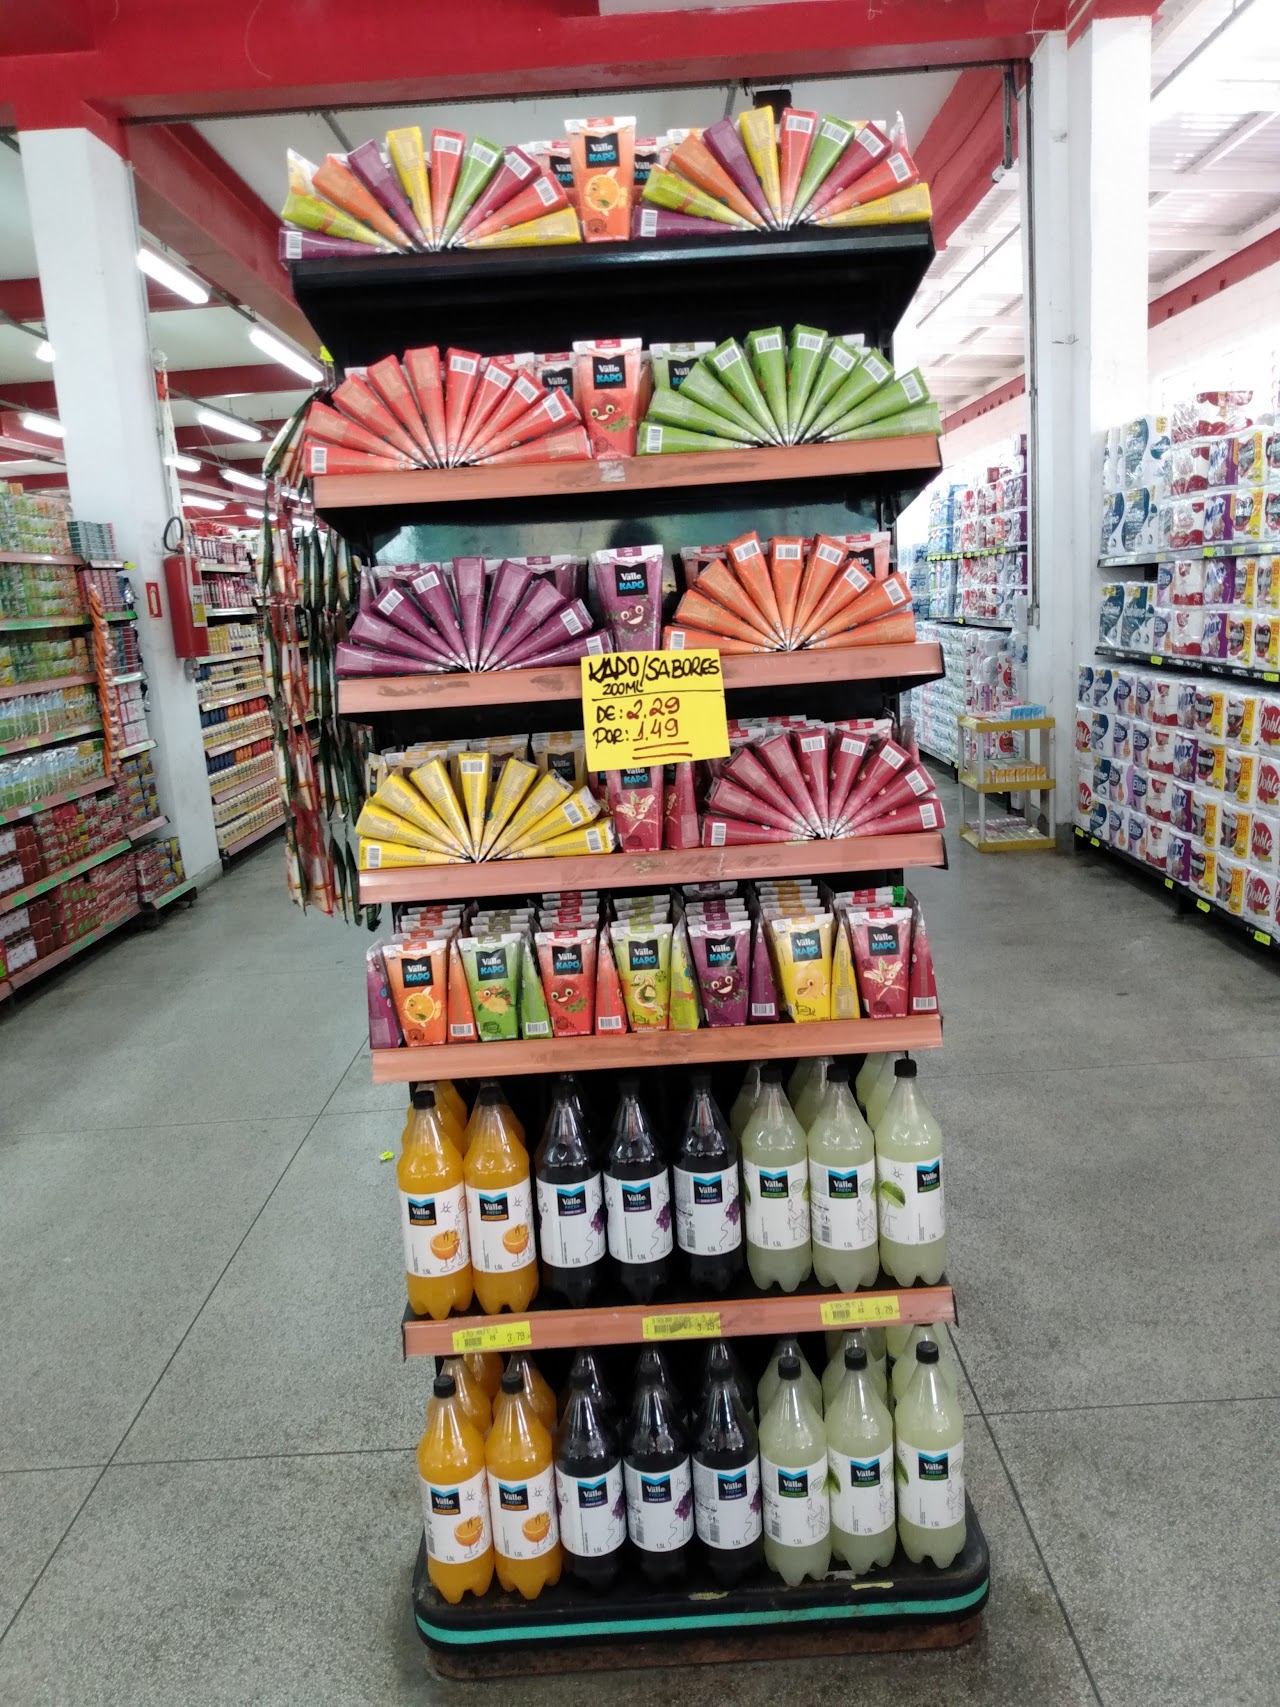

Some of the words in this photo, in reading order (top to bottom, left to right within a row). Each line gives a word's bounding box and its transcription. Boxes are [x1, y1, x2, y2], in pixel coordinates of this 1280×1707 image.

[598, 364, 620, 373] Valle
[620, 571, 642, 580] Valle
[873, 933, 893, 941] Valle
[796, 938, 816, 946] Valle
[634, 947, 654, 955] Valle
[711, 944, 731, 952] Valle
[557, 952, 577, 960] Valle
[407, 964, 428, 972] Valle
[921, 1172, 938, 1181] Valle
[764, 1180, 784, 1188] Valle
[833, 1180, 853, 1188] Valle
[698, 1186, 718, 1194] Valle
[562, 1197, 581, 1206] Valle
[627, 1193, 647, 1202] Valle
[483, 1202, 503, 1211] Valle
[411, 1207, 431, 1216] Valle
[923, 1462, 944, 1471] Valle
[723, 1482, 743, 1490] Valle
[783, 1479, 803, 1487] Valle
[646, 1485, 666, 1493] Valle
[503, 1492, 523, 1501] Valle
[583, 1490, 603, 1498] Valle
[435, 1497, 454, 1505] Valle
